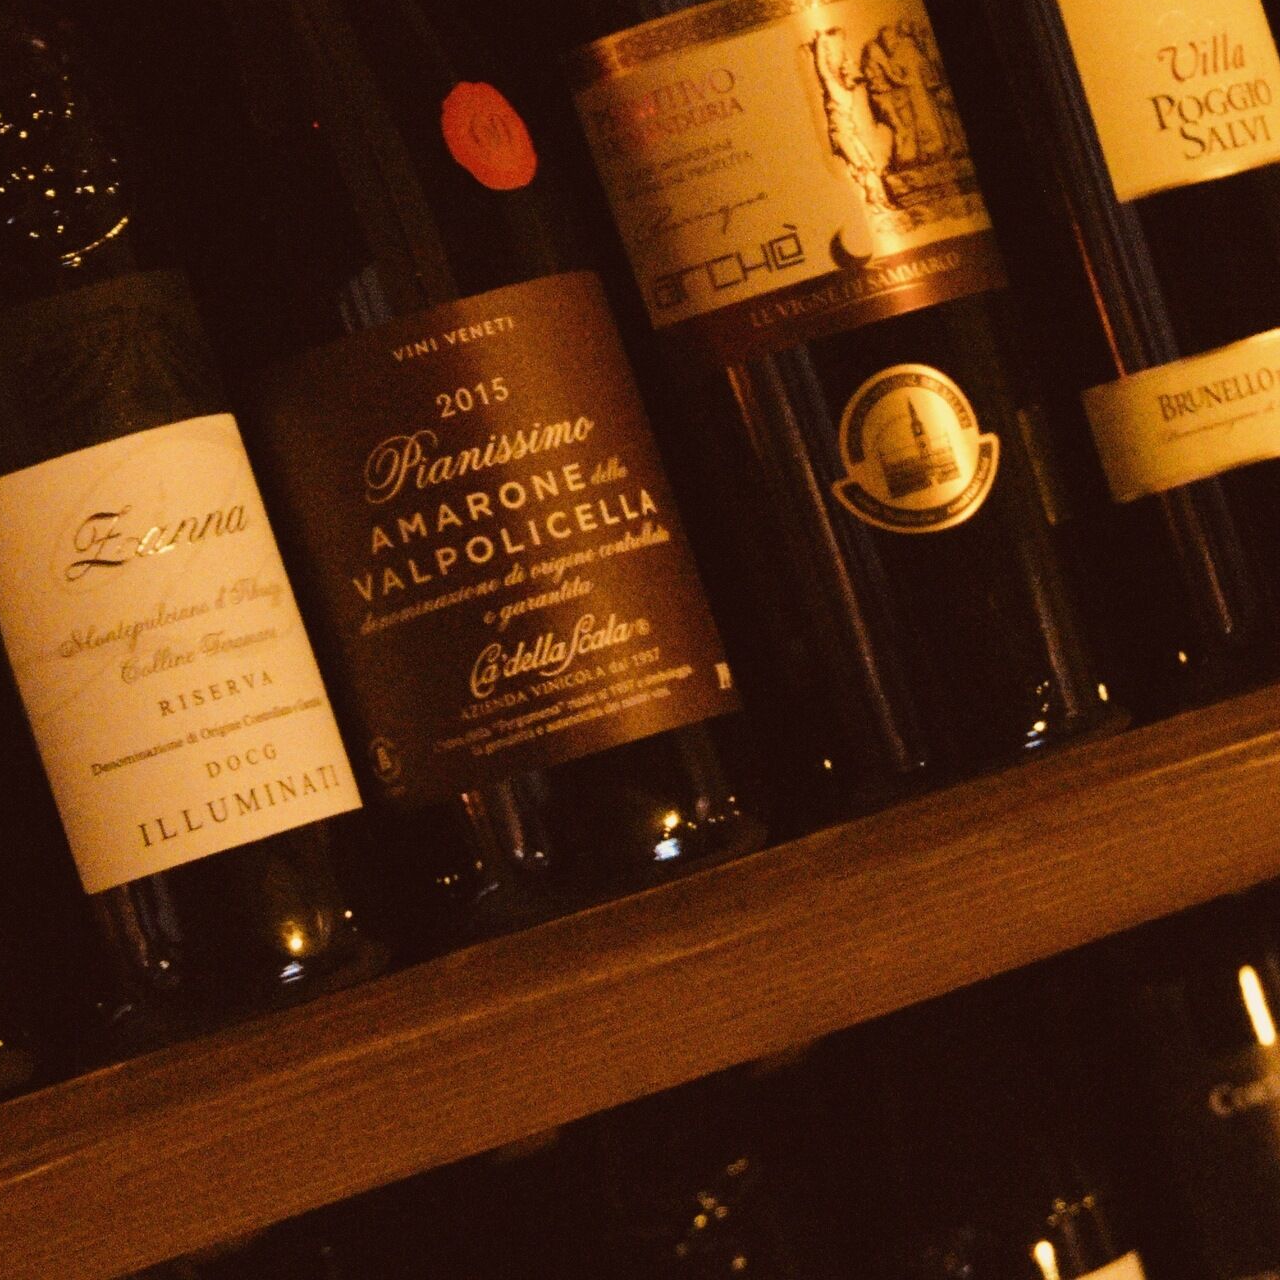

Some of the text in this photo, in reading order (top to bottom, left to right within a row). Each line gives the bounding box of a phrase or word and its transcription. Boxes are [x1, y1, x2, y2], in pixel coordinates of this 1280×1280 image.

[1157, 32, 1246, 85] Villa
[1147, 75, 1273, 135] POGGIO
[1179, 110, 1272, 162] SALVI
[392, 314, 516, 363] VINI VENETI
[435, 376, 511, 419] 2015
[1157, 363, 1276, 423] BRUNELLO
[363, 413, 595, 505] Pianissimo
[371, 462, 588, 556] AMARONE
[64, 502, 250, 583] Zanna
[352, 487, 660, 603] VALPOLICELLA
[119, 649, 195, 686] Colline
[157, 669, 275, 717] RISERVA
[460, 689, 529, 720] AZIENDA
[530, 663, 607, 699] VINICOLA
[205, 742, 279, 779] DOCG
[136, 763, 342, 848] ILLUMINATI
